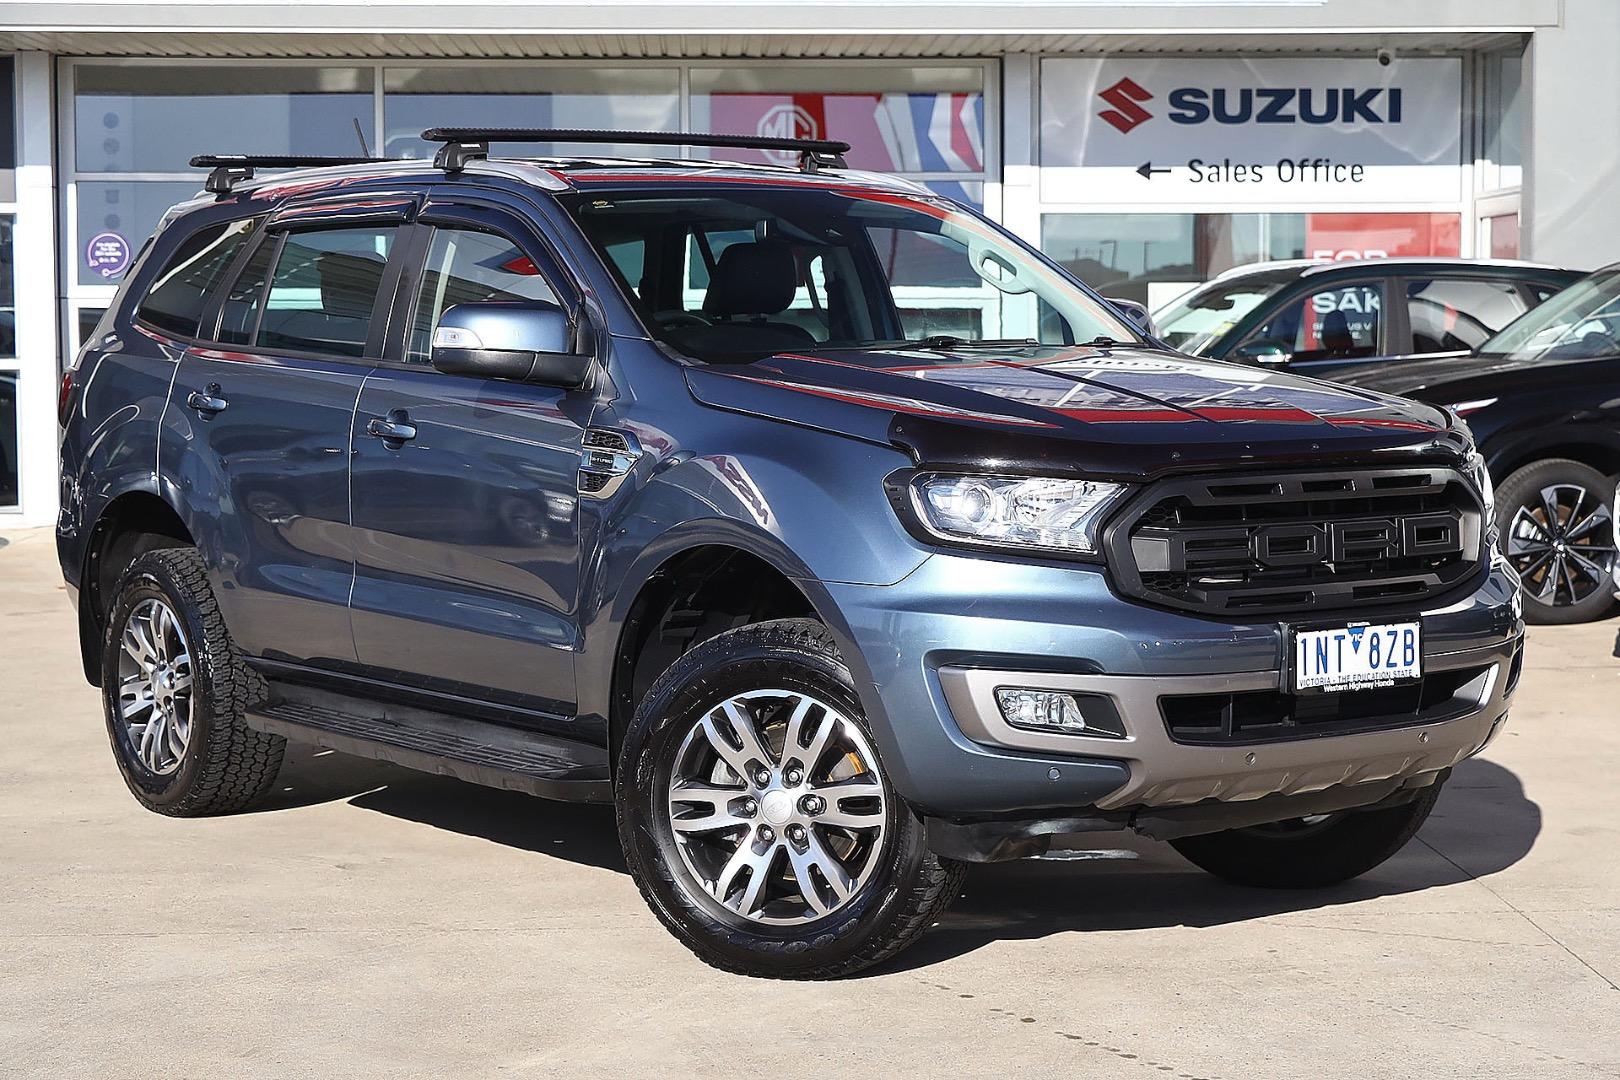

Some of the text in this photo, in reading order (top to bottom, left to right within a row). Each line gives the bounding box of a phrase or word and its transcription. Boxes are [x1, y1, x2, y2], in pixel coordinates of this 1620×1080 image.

[1168, 88, 1401, 124] SUZUKI
[1188, 159, 1365, 183] Sales Office
[1181, 511, 1466, 572] FORD
[1301, 629, 1415, 676] 1NT 8ZB
[1299, 677, 1331, 688] VICTORIA
[1338, 674, 1350, 683] THE
[1353, 670, 1391, 681] EDUCATION
[1393, 669, 1412, 678] STATE
[1375, 678, 1394, 687] Honda
